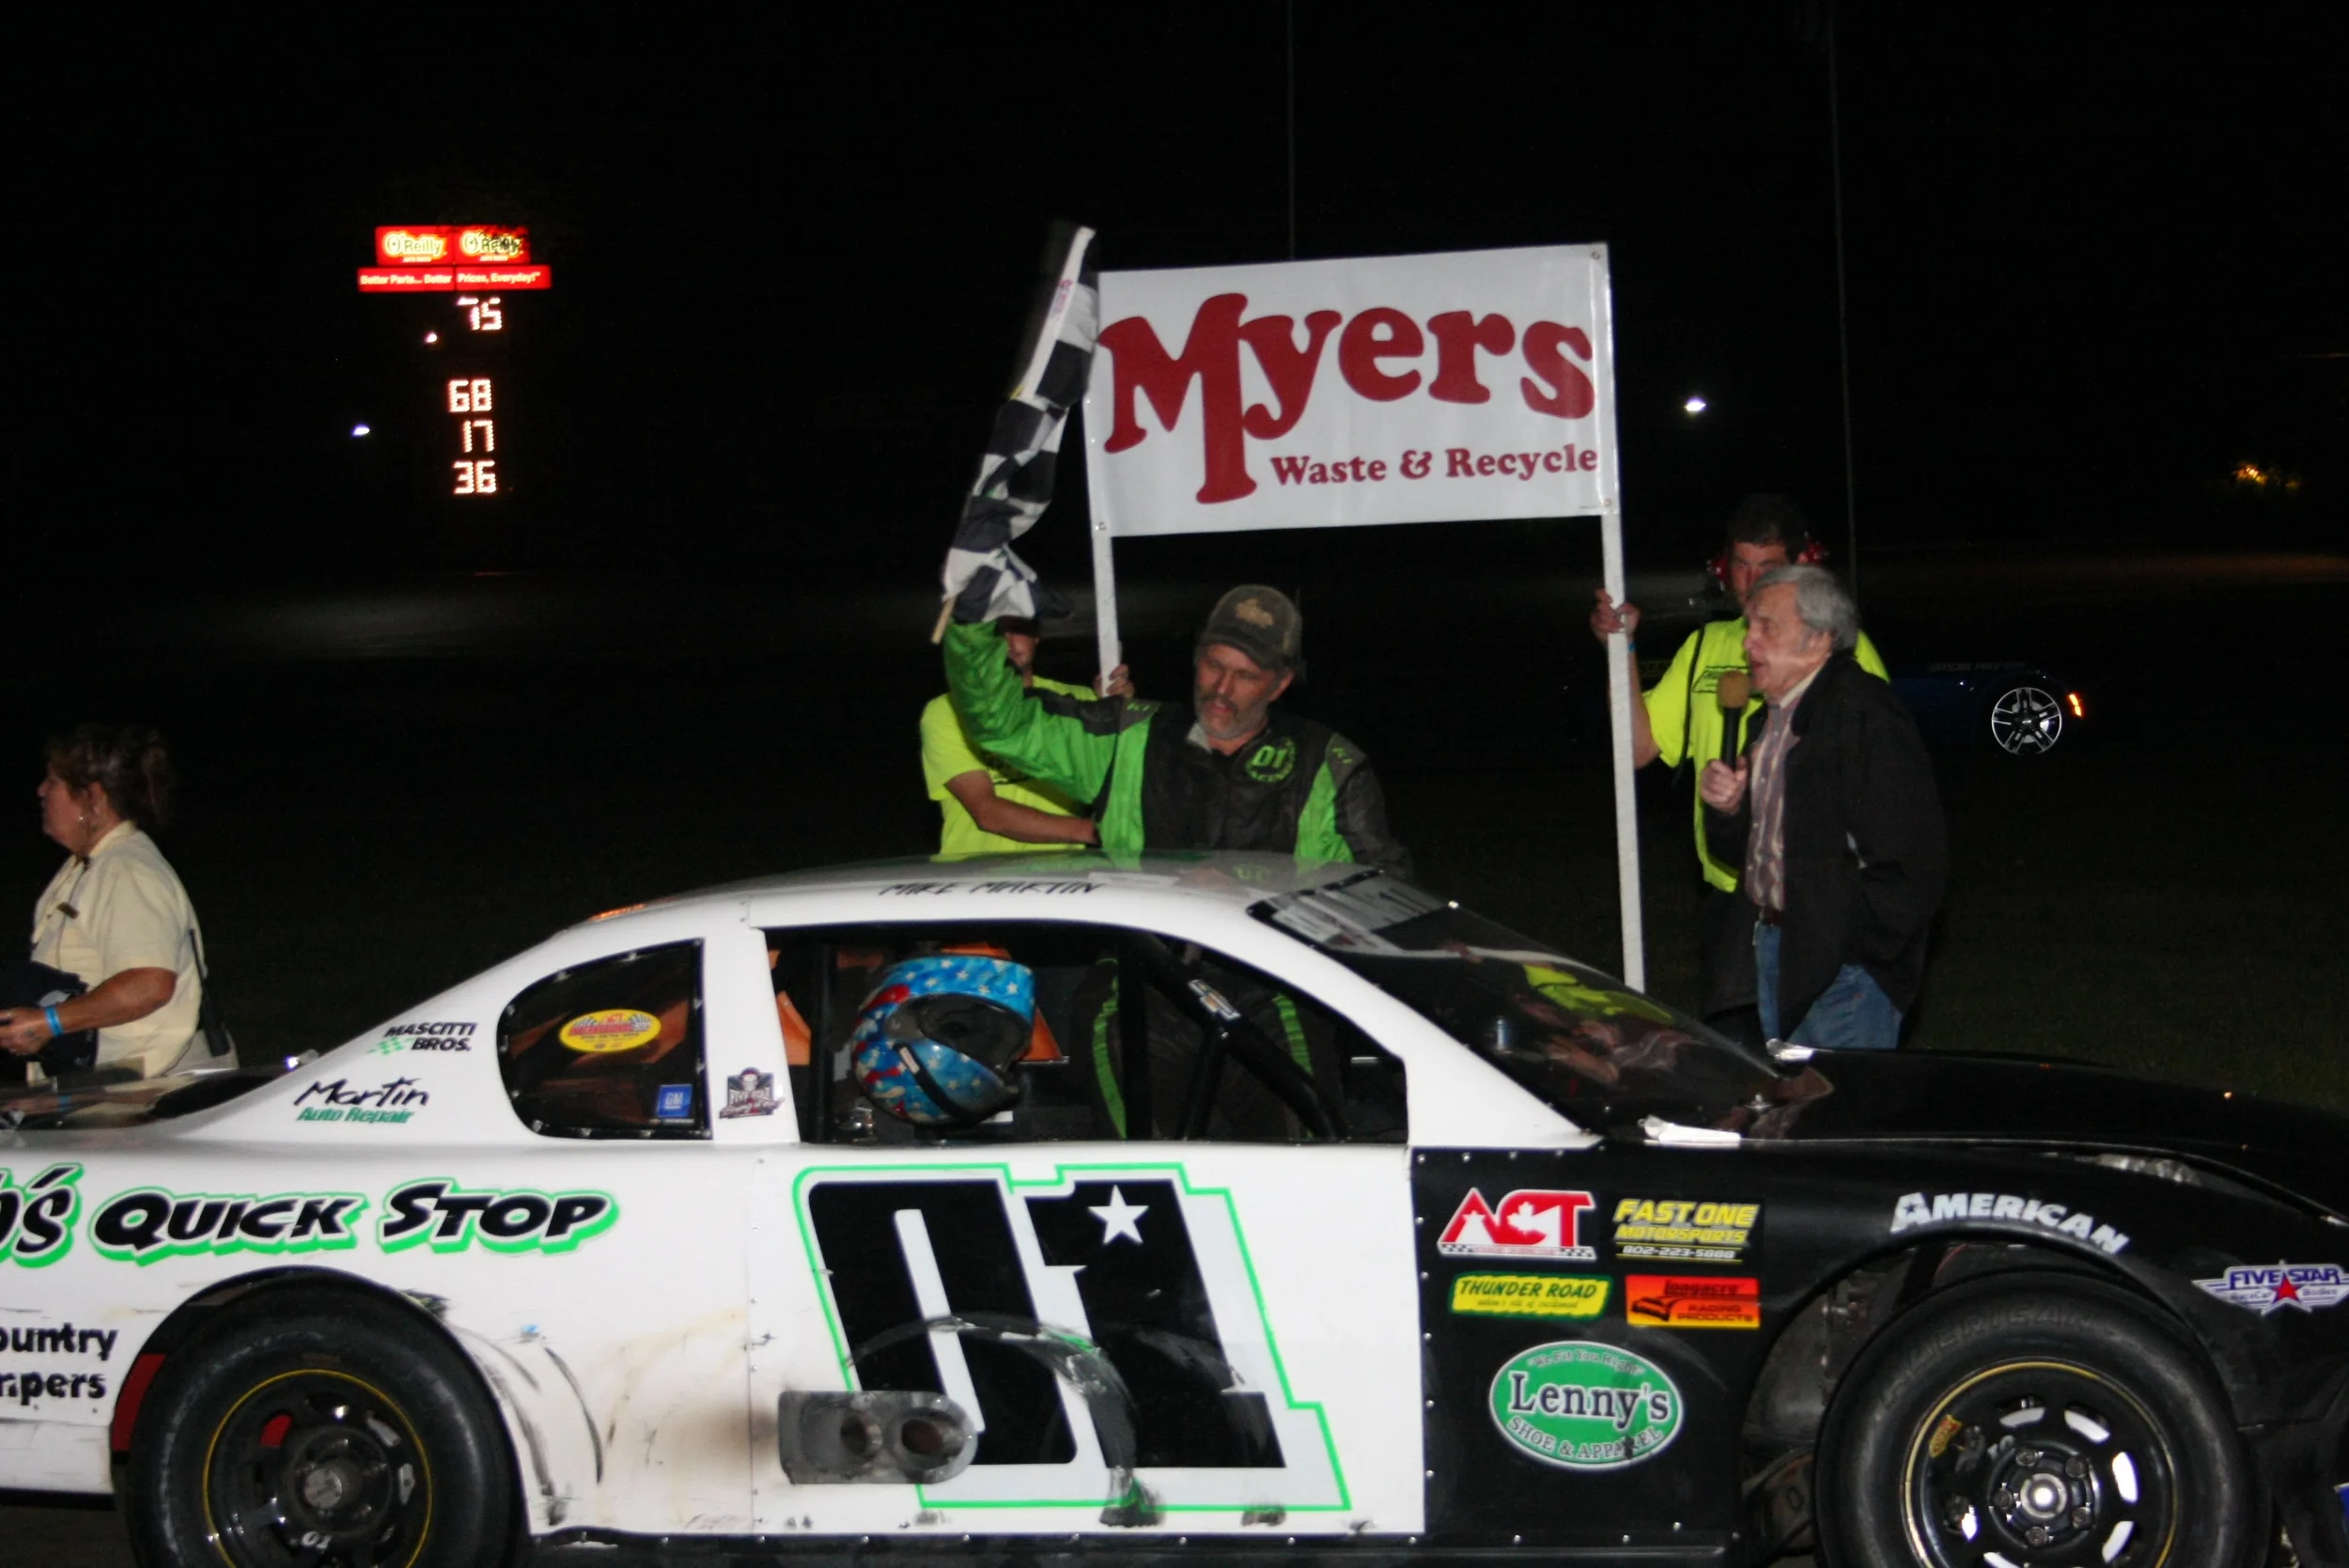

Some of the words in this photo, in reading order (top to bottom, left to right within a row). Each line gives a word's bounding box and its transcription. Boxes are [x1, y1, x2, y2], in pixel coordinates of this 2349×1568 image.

[384, 231, 444, 257] O'Reilly
[360, 274, 388, 285] Better
[424, 273, 452, 284] Better
[458, 296, 502, 330] 75
[448, 379, 492, 412] 68
[1097, 292, 1595, 505] Myers
[462, 419, 495, 453] 17
[453, 460, 496, 493] 36
[1270, 456, 1388, 486] Waste
[1399, 449, 1433, 480] &
[1445, 443, 1597, 480] Recycle
[969, 880, 1107, 894] MARTIN
[383, 1021, 479, 1038] MASCITTI
[411, 1037, 473, 1051] BROS.
[293, 1077, 430, 1108] Martin
[296, 1107, 343, 1121] Auto
[344, 1107, 416, 1124] Repair
[92, 1189, 366, 1257] QUICK
[380, 1180, 613, 1246] STOP
[1439, 1189, 1595, 1250] ACT
[1612, 1198, 1697, 1225] FAST
[1693, 1202, 1761, 1229] ONE
[1890, 1191, 2131, 1255] AMERICAN
[1614, 1225, 1750, 1246] MOTORSPORTS
[1622, 1246, 1736, 1259] 802-223-5888
[1459, 1280, 1543, 1297] THUNDER
[1546, 1282, 1597, 1298] ROAD
[2229, 1269, 2281, 1290] FIVE
[2287, 1267, 2341, 1285] STAR
[1553, 1348, 1573, 1362] Fit
[1574, 1348, 1598, 1362] You
[1509, 1371, 1672, 1433] Lenny's
[1506, 1415, 1556, 1452] SHOE
[1558, 1439, 1574, 1457] &
